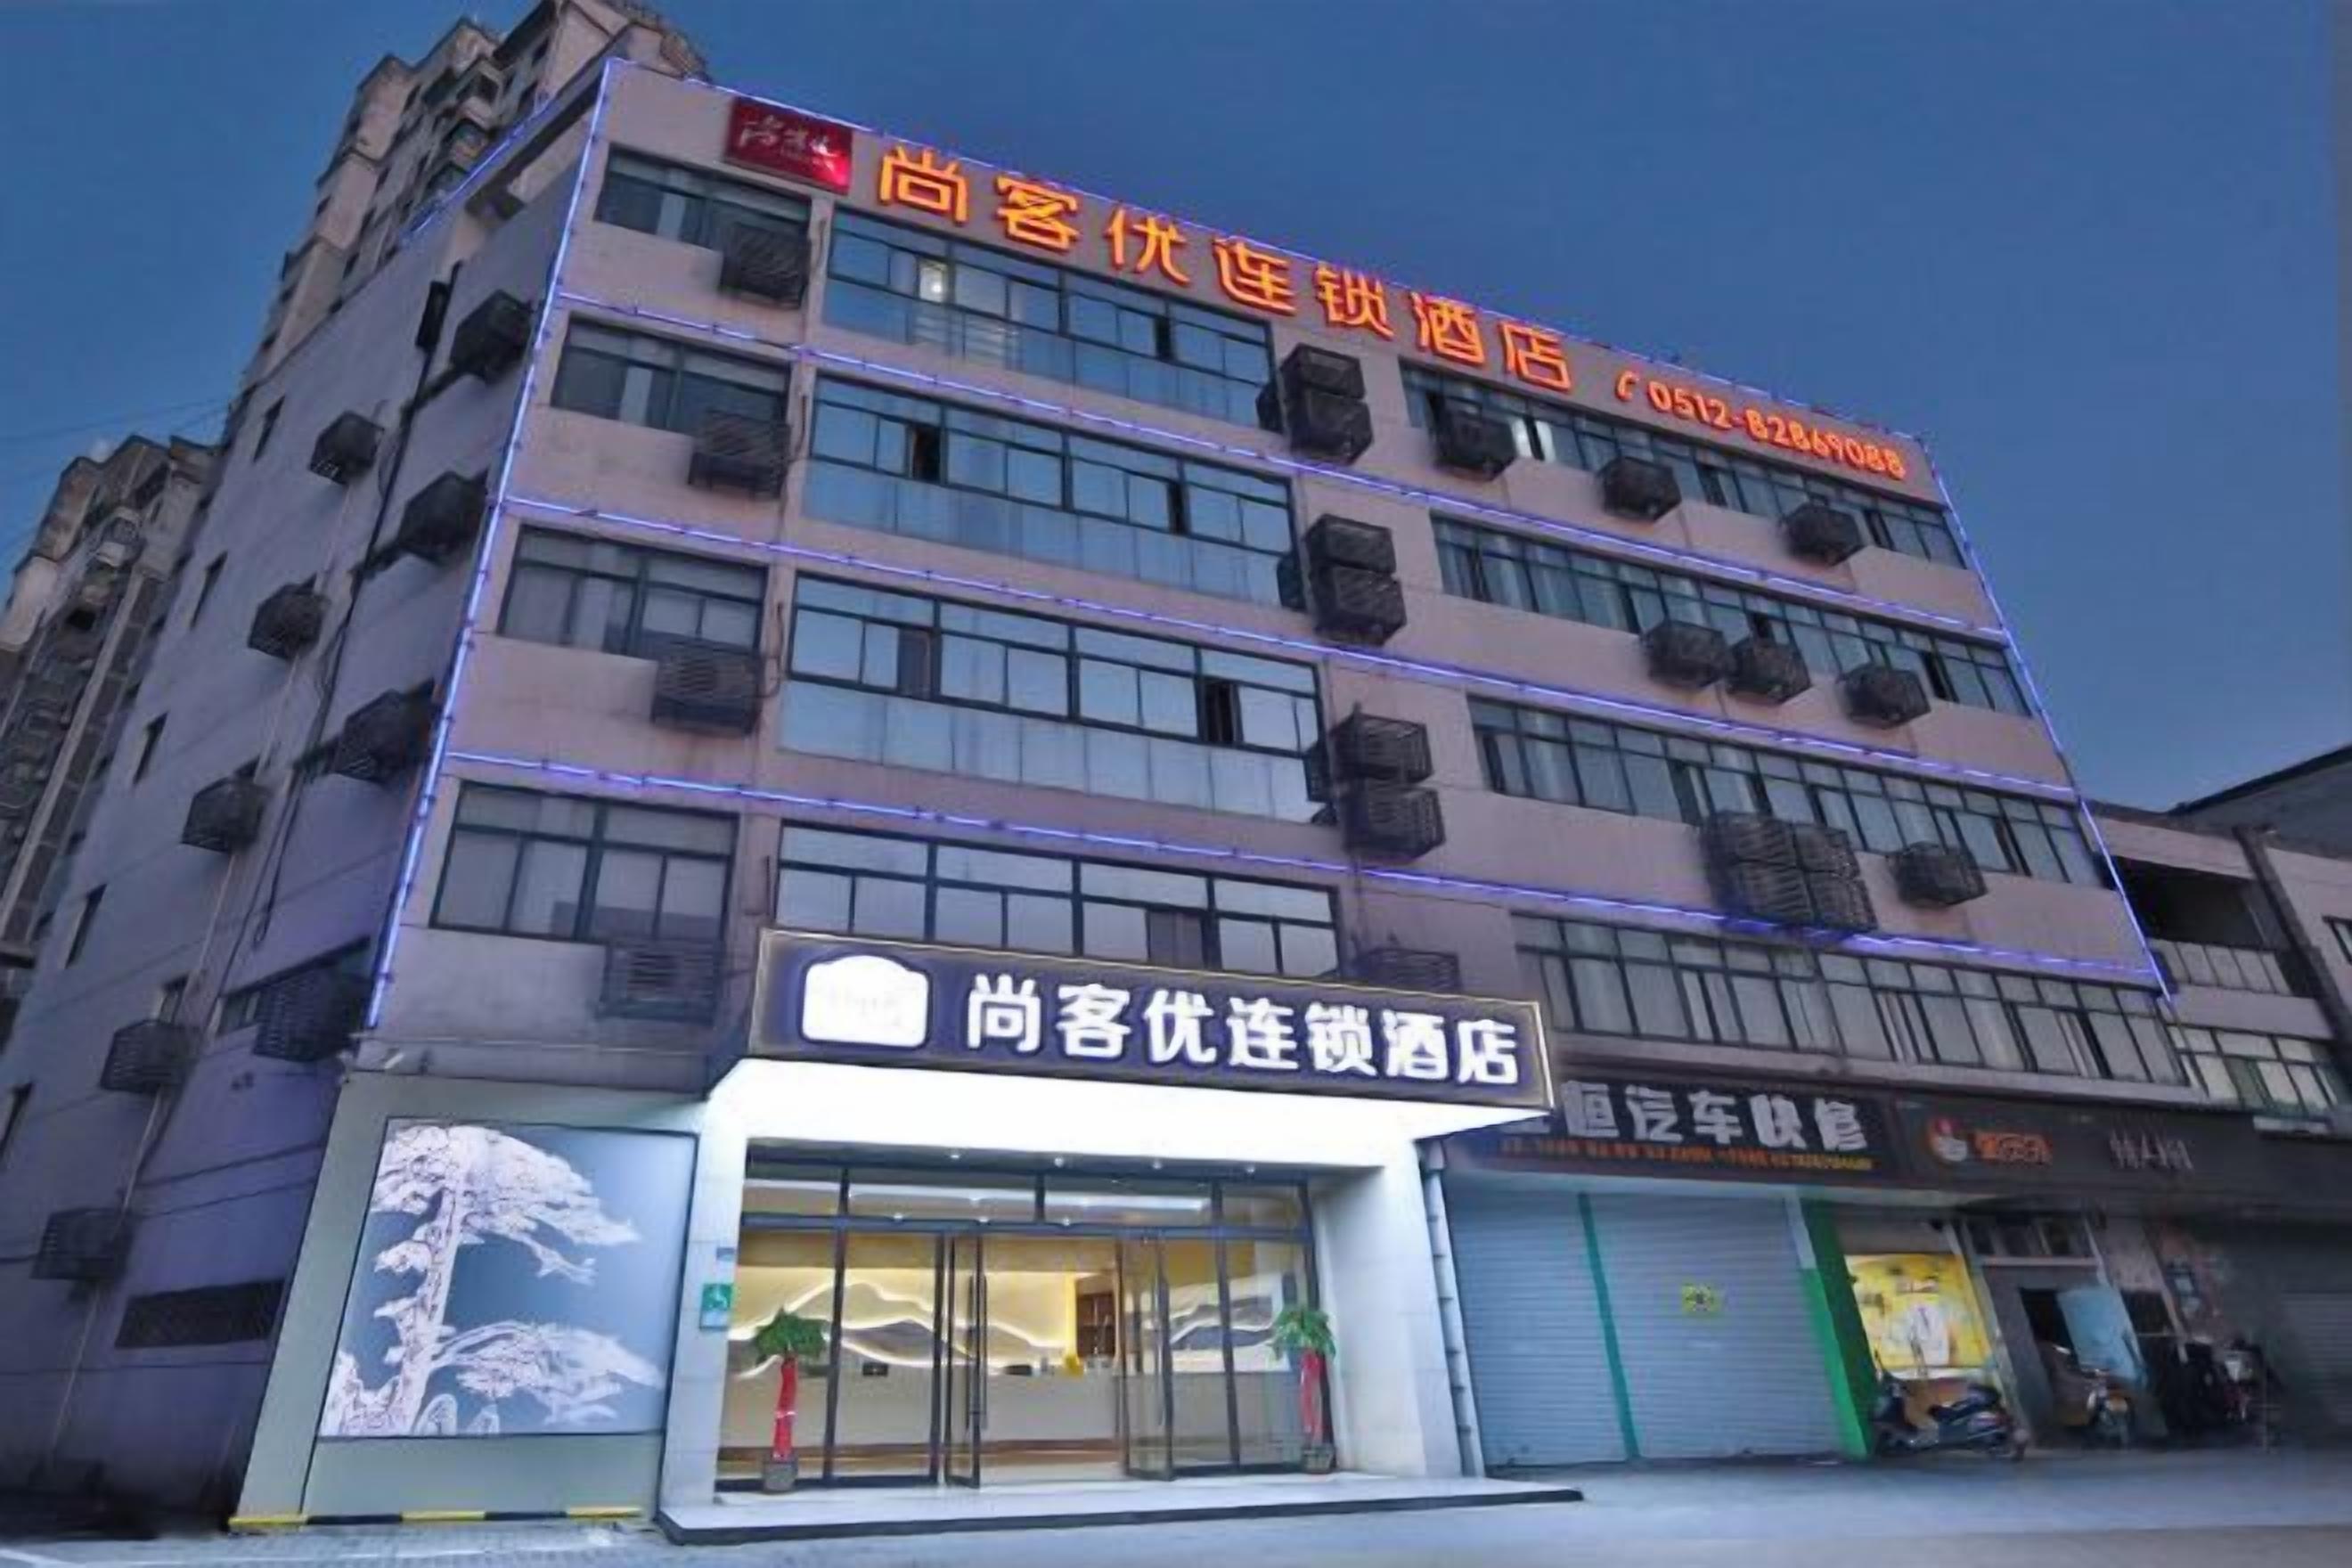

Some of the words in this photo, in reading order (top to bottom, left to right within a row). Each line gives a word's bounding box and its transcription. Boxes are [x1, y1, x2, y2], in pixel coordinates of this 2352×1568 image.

[878, 146, 1572, 390] 尚客优连锁酒店
[1647, 372, 1906, 478] 0512-82869088
[967, 973, 1520, 1085] 尚客优连锁酒店
[1501, 1080, 1868, 1152] 恒汽车快修
